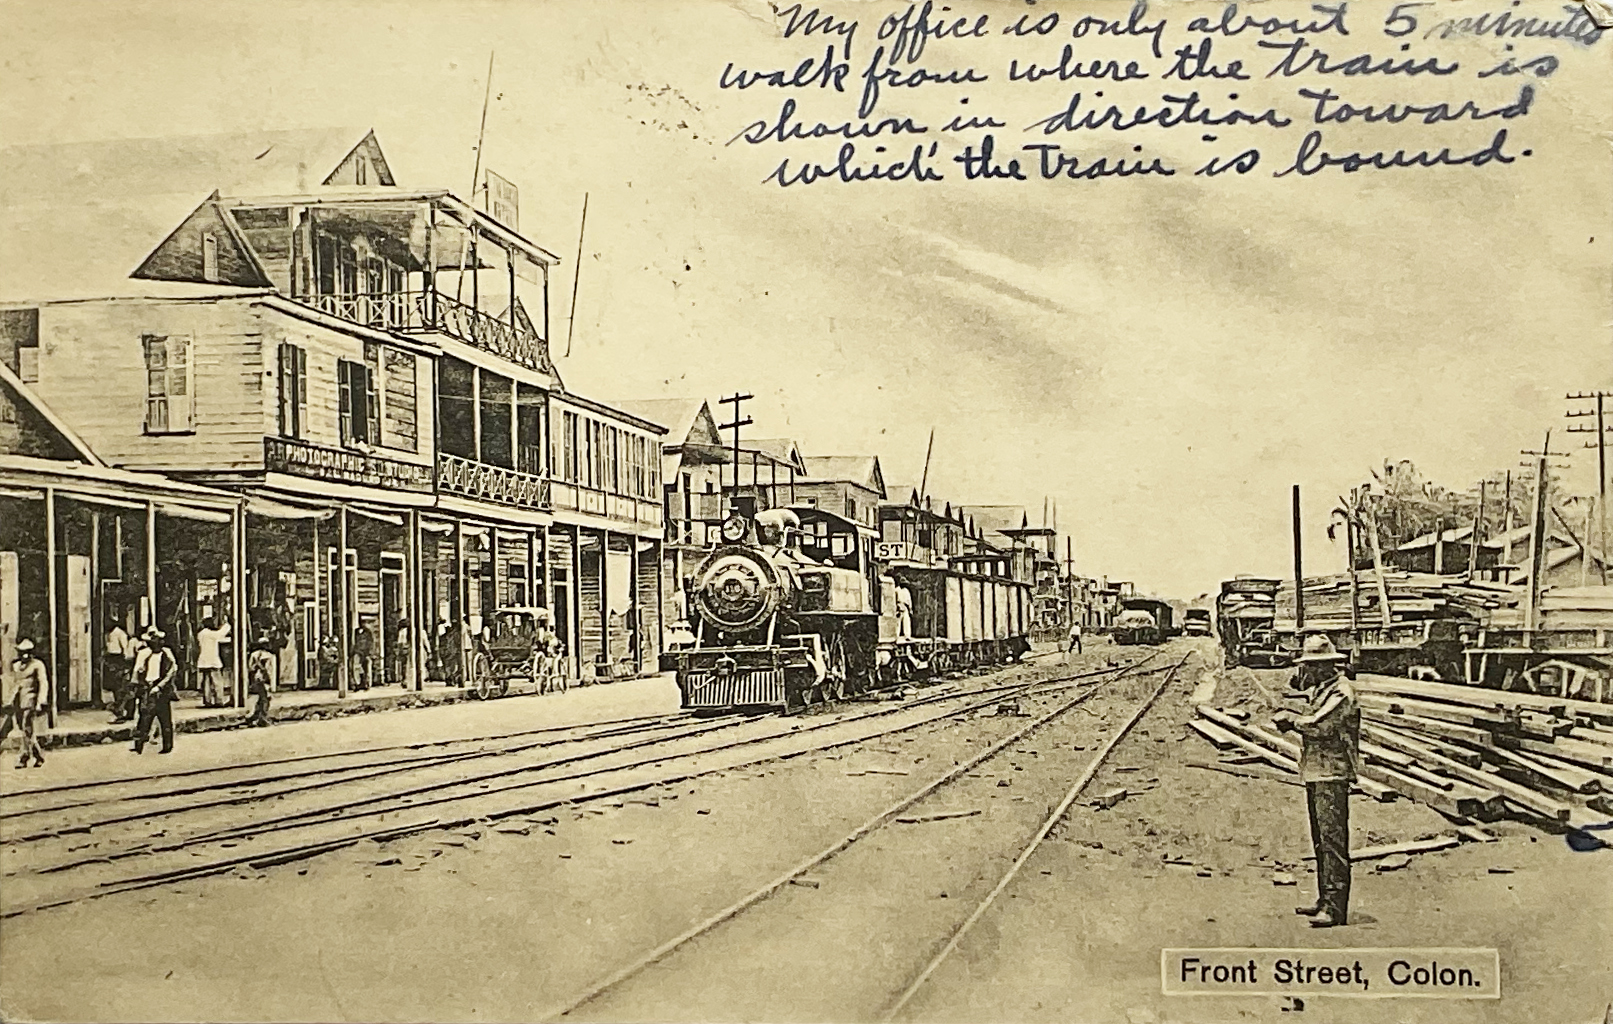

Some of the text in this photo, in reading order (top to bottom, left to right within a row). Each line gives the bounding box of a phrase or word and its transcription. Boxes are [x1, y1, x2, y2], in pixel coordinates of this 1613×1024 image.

[776, 4, 859, 60] My
[877, 0, 990, 65] office
[1002, 0, 1060, 37] is
[1072, 4, 1168, 59] only
[1187, 3, 1350, 36] about
[1383, 2, 1437, 38] 5
[719, 45, 850, 91] walk
[858, 46, 989, 119] from
[1009, 44, 1150, 82] where
[1161, 42, 1251, 81] the
[1477, 44, 1560, 78] is
[724, 84, 1535, 147] shown in direction toward
[953, 135, 1028, 182] the
[1194, 135, 1261, 177] is
[1272, 129, 1534, 178] bound.
[285, 443, 365, 473] PHOTOGRAPHIC
